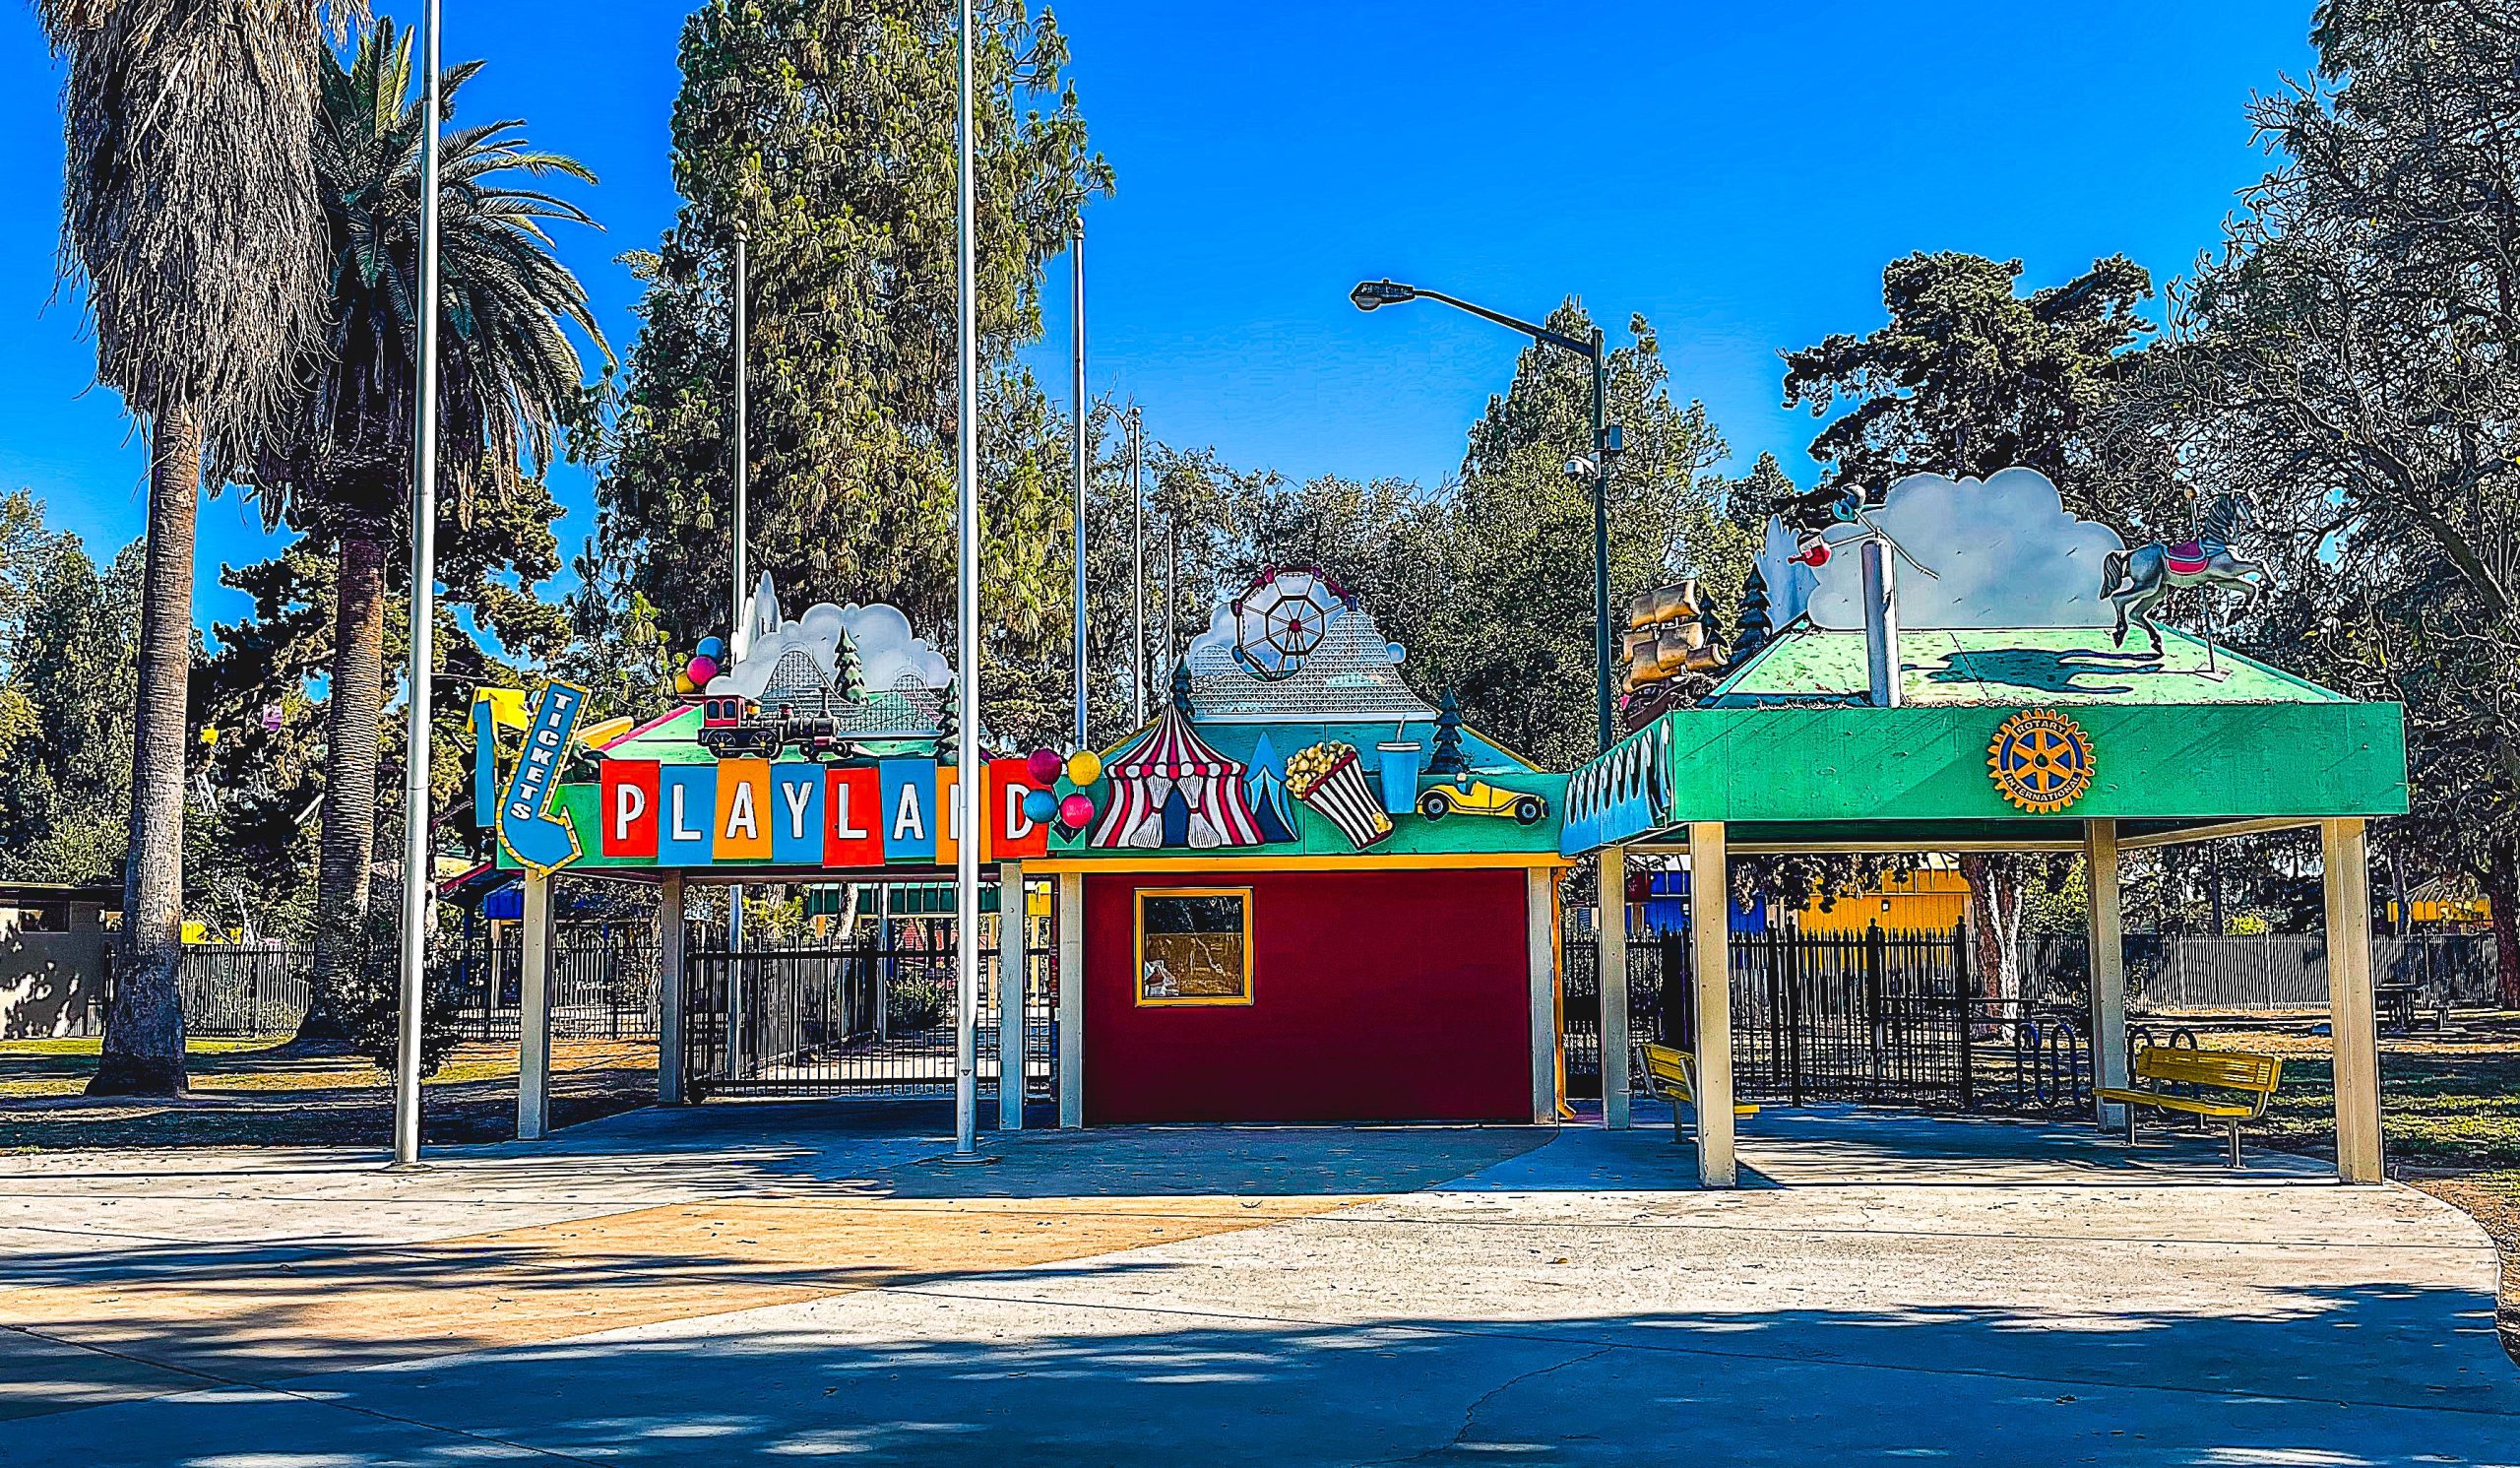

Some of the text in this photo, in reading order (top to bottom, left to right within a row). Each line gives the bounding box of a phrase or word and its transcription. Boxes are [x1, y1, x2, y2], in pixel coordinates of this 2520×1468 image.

[2016, 720, 2066, 734] ROTARY
[510, 692, 574, 820] TICKETS
[2004, 775, 2081, 801] INTERNATIONAL
